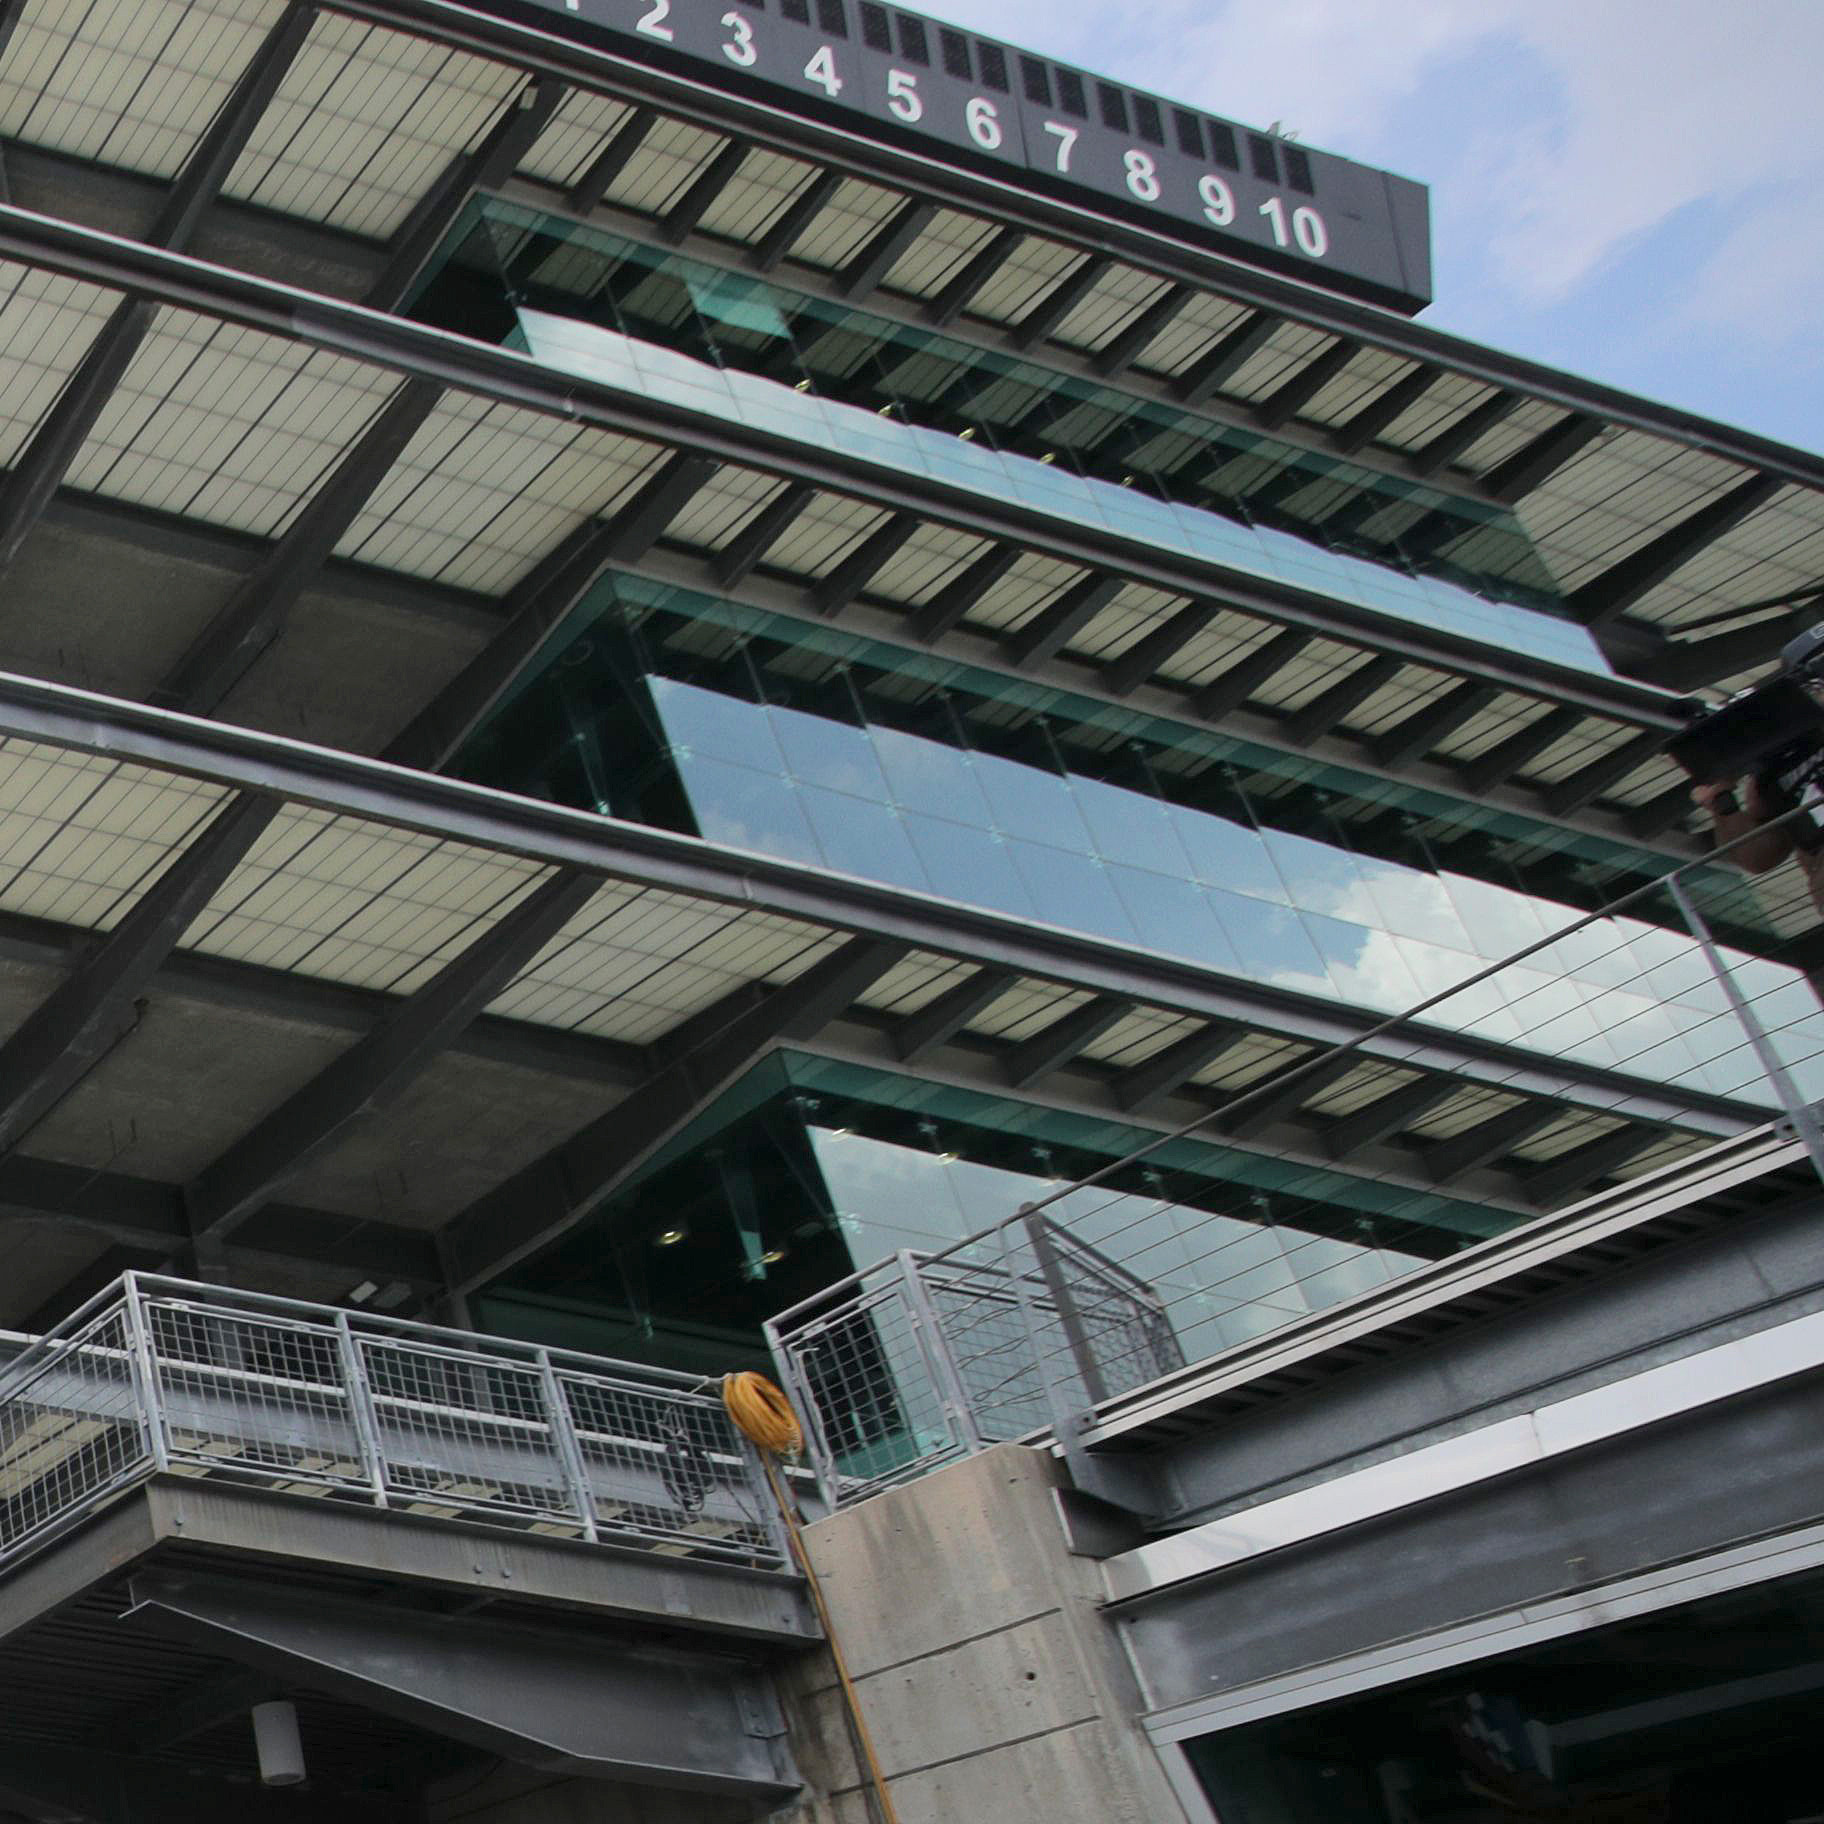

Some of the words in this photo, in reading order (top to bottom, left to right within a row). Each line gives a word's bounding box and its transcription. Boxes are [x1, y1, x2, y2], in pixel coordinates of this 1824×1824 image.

[721, 12, 758, 66] 3
[804, 46, 843, 99] 4
[888, 69, 924, 124] 5
[965, 97, 1002, 151] 6
[1043, 121, 1079, 175] 7
[1122, 149, 1160, 203] 8
[1198, 175, 1236, 229] 9
[1258, 198, 1328, 261] 10
